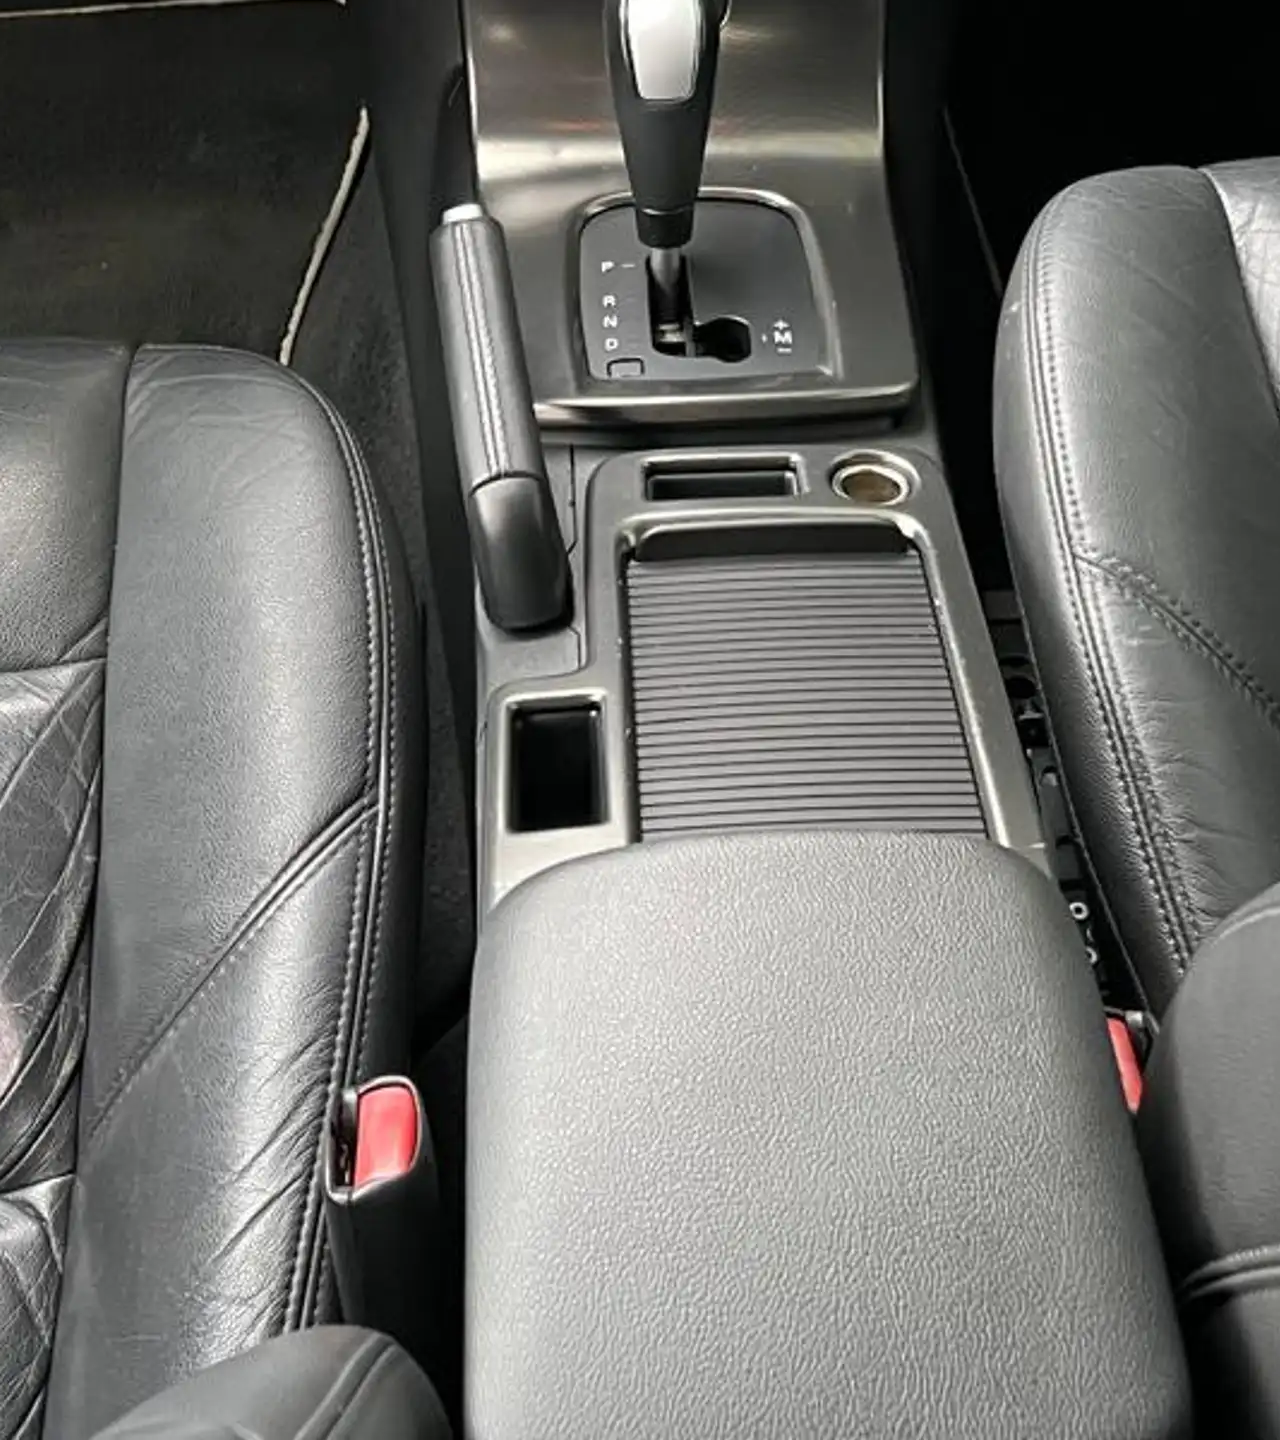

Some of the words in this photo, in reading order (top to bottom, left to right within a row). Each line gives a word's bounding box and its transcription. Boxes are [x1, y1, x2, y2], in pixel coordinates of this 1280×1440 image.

[601, 260, 615, 273] P
[602, 295, 616, 308] R
[602, 314, 618, 328] N
[773, 330, 793, 345] M
[604, 338, 618, 352] D
